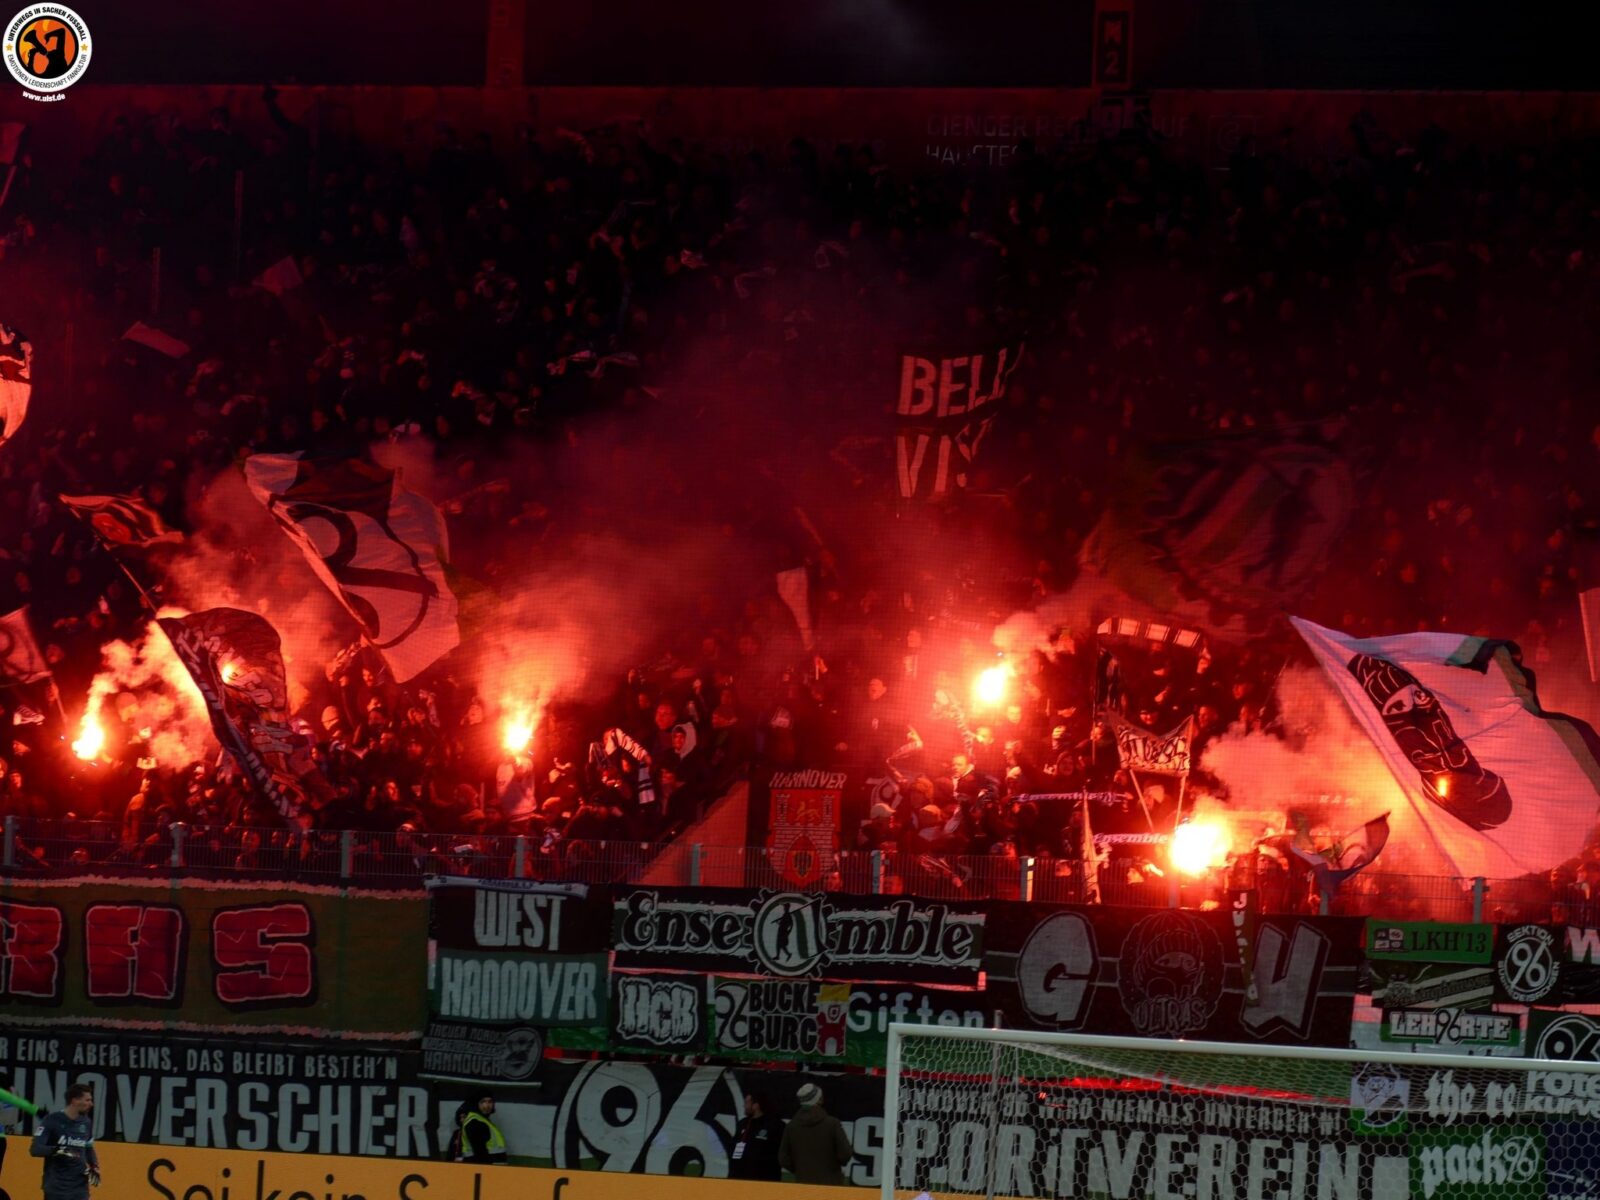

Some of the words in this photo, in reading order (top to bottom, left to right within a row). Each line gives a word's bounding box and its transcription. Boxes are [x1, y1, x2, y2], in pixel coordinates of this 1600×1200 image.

[768, 769, 848, 789] HANNOVER
[473, 887, 568, 951] WEST
[1506, 924, 1555, 946] SEKTION
[440, 957, 598, 1021] HANNOVER
[847, 991, 986, 1034] Giften
[1133, 997, 1206, 1033] ULTRAS
[748, 1014, 819, 1055] BURG
[16, 1038, 65, 1066] EINS,
[73, 1042, 121, 1068] ABER
[129, 1045, 178, 1073] EINS,
[186, 1048, 225, 1074] DAS
[233, 1052, 295, 1078] BLEIBT
[1102, 1097, 1194, 1126] NIEMALS
